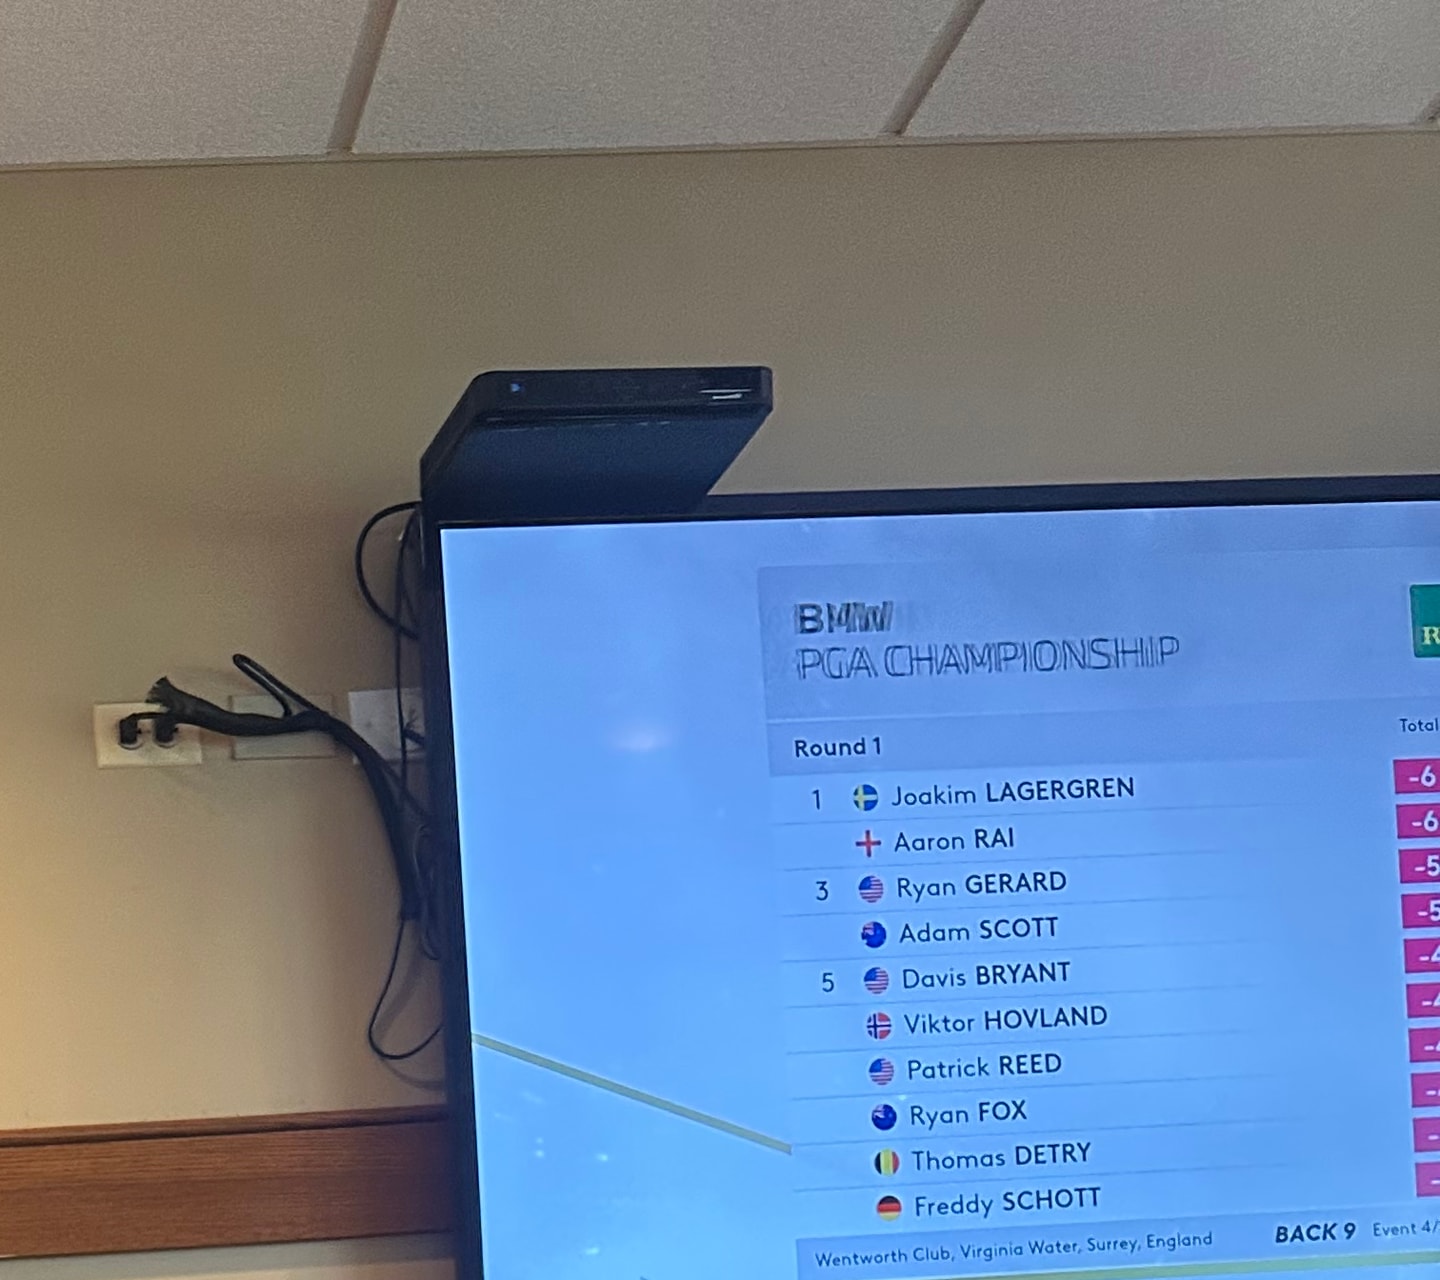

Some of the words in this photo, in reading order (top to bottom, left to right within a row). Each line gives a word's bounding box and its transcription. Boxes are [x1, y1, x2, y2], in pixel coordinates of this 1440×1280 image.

[796, 601, 893, 634] BMW
[797, 646, 878, 679] PGA
[884, 636, 1180, 678] CHAMPIONSHIP
[1399, 718, 1438, 732] Total
[795, 738, 866, 757] Round
[873, 737, 881, 754] 1
[1409, 765, 1436, 787] -6
[812, 789, 820, 809] 1
[892, 784, 976, 806] Joakim
[986, 777, 1135, 803] LAGERGREN
[1412, 810, 1439, 832] -6
[895, 832, 965, 852] Aaron
[974, 828, 1015, 849] RAI
[1415, 855, 1440, 877] -5
[816, 881, 828, 901] 3
[898, 878, 956, 903] Ryan
[965, 872, 1067, 894] GERARD
[899, 922, 970, 943] Adam
[980, 917, 1058, 940] SCOTT
[822, 972, 835, 992] 5
[903, 968, 967, 989] Davis
[976, 961, 1071, 986] BRYANT
[904, 1013, 975, 1034] Viktor
[985, 1005, 1108, 1030] HOVLAND
[908, 1056, 990, 1080] Patrick
[1000, 1053, 1061, 1076] REED
[911, 1105, 969, 1130] Ryan
[979, 1100, 1027, 1122] FOX
[912, 1150, 1005, 1171] Thomas
[1015, 1142, 1091, 1166] DETRY
[915, 1194, 993, 1218] Freddy
[1003, 1187, 1101, 1211] SCHOTT
[815, 1248, 908, 1267] Wentworth
[913, 1246, 955, 1262] Club,
[960, 1242, 1023, 1262] Virginia
[1028, 1239, 1081, 1255] Water,
[1087, 1237, 1141, 1254] Surrey,
[1146, 1231, 1213, 1252] England
[1275, 1223, 1338, 1244] BACK
[1344, 1222, 1356, 1240] 9
[1373, 1222, 1417, 1237] Event
